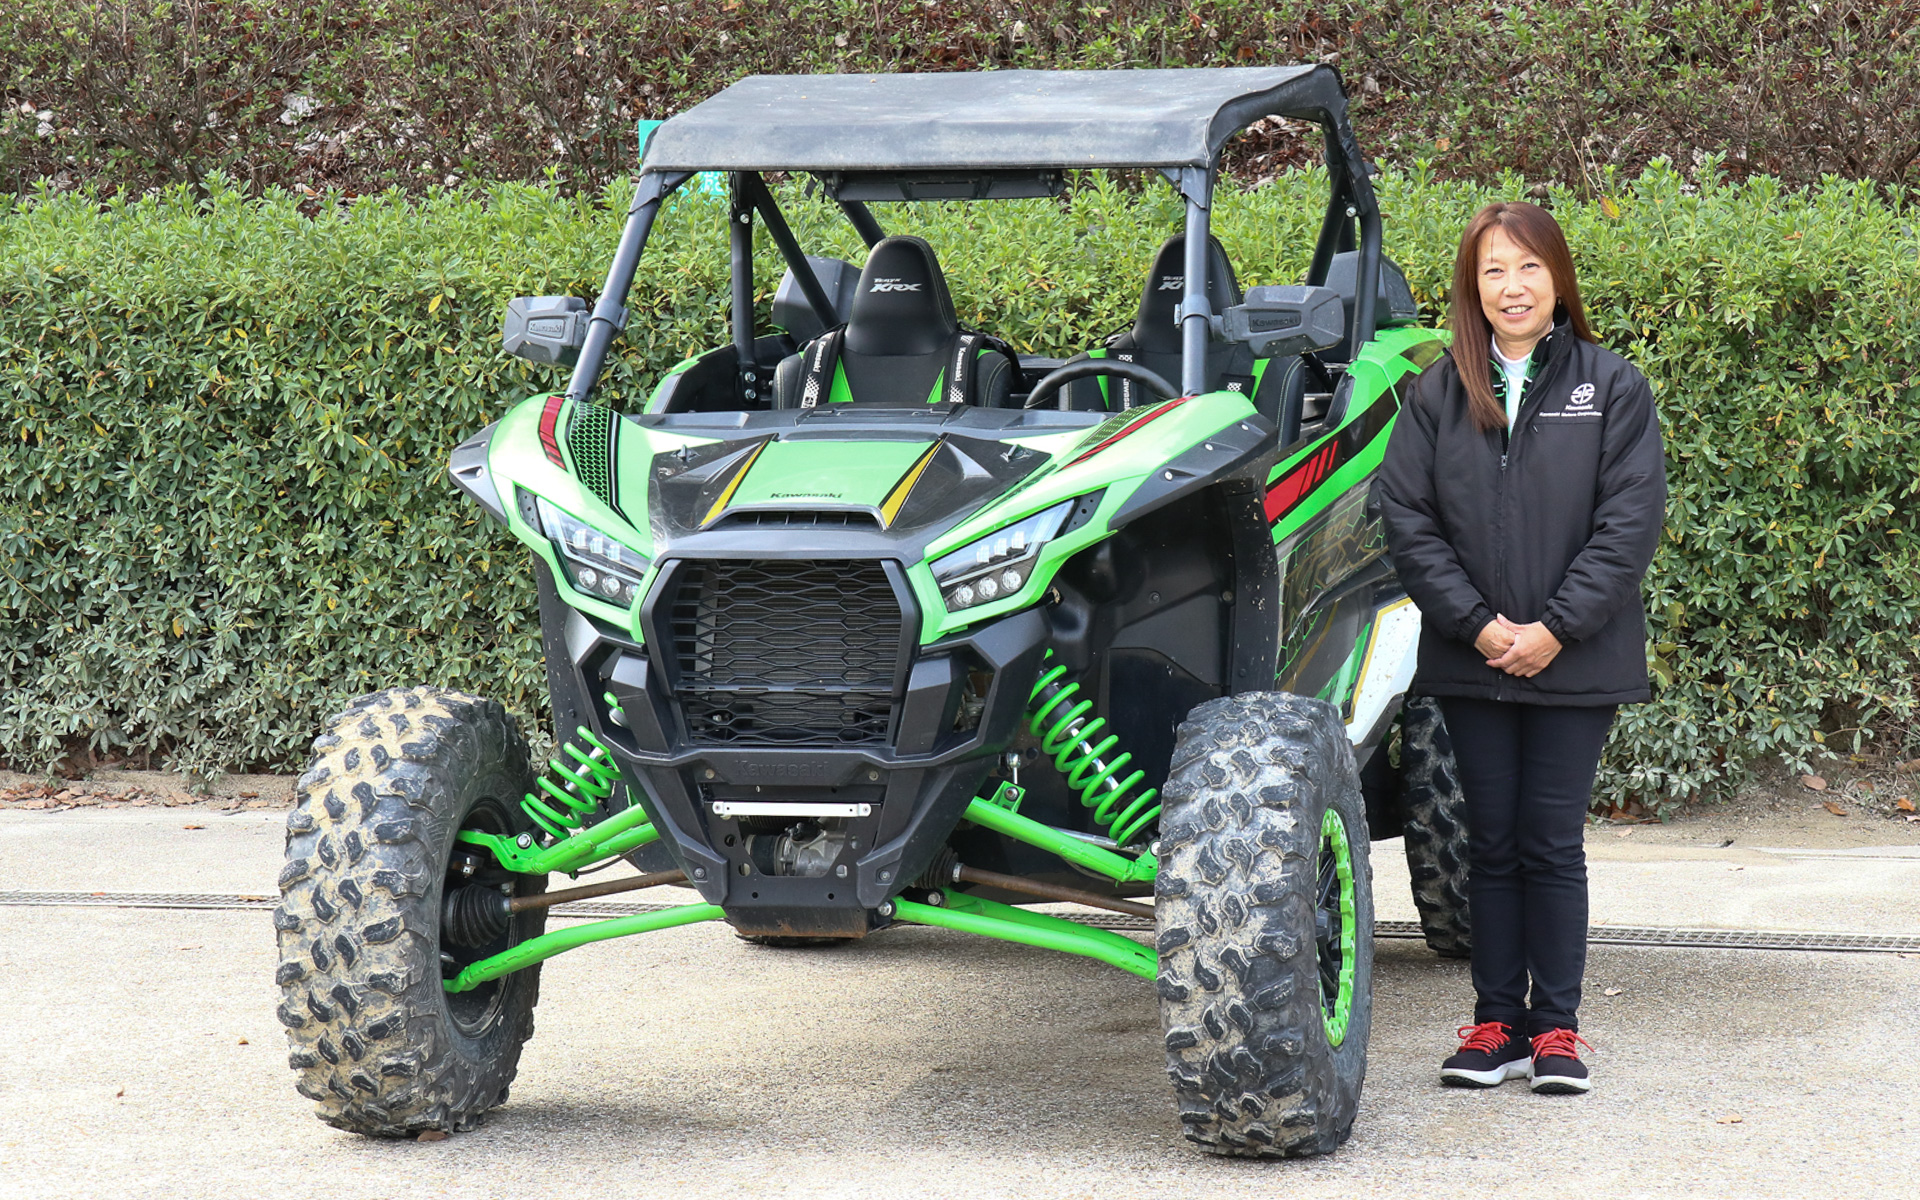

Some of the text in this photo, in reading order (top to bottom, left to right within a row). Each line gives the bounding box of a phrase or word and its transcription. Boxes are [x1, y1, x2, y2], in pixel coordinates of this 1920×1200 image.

[869, 283, 922, 293] KRX
[529, 322, 562, 332] Kawasaki
[1252, 317, 1298, 326] Kawasaki
[812, 341, 827, 373] Kawasaki
[954, 346, 967, 382] Kawasaki
[735, 760, 829, 777] Kawasaki
